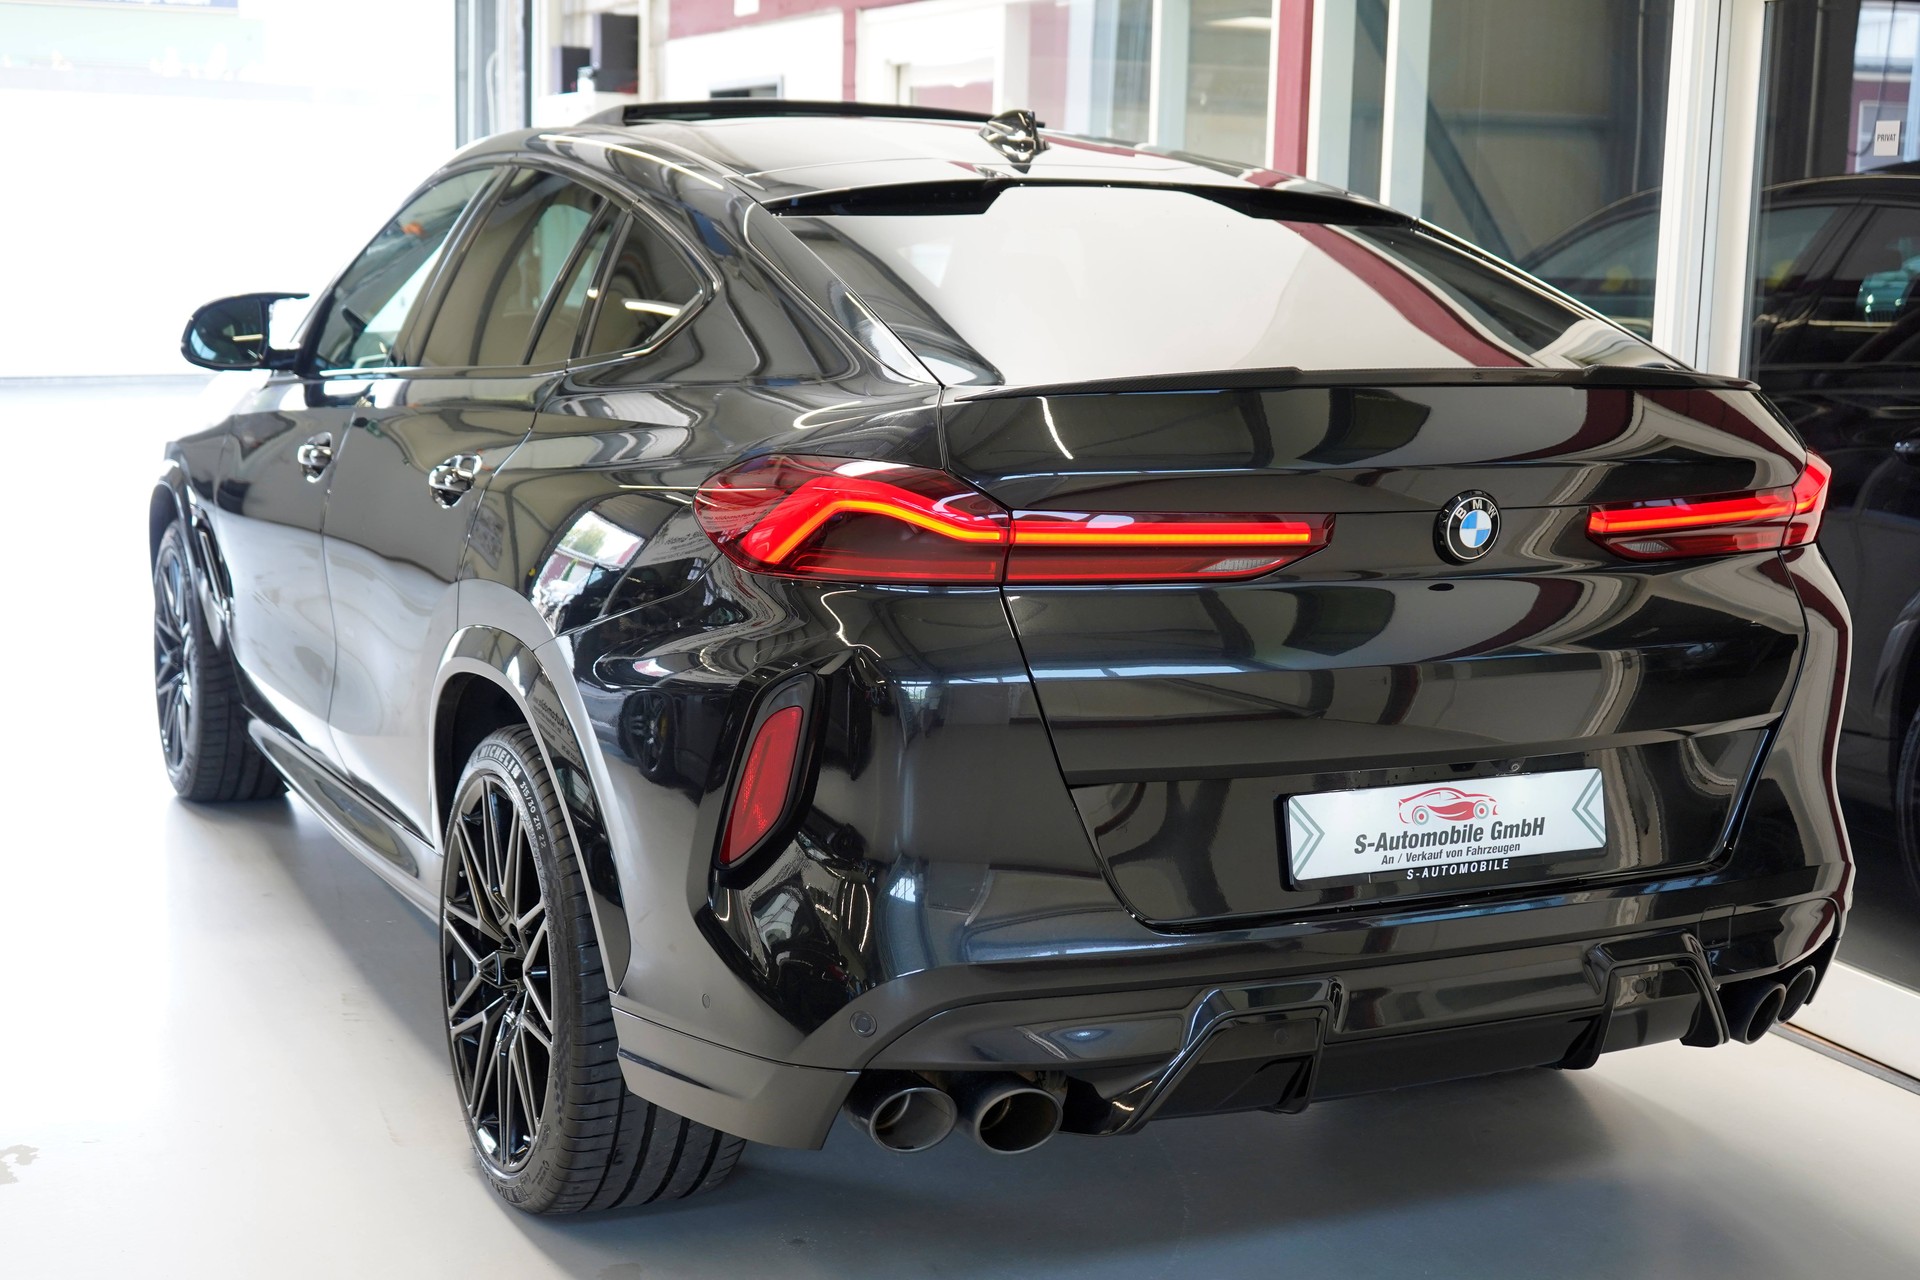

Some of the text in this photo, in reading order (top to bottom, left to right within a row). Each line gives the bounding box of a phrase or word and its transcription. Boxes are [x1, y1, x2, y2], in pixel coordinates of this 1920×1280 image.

[1877, 133, 1896, 142] PRIVAT
[1455, 499, 1497, 520] BMW
[480, 745, 522, 779] MICHELIN
[519, 781, 536, 813] 315/30
[533, 815, 542, 831] ZR
[539, 834, 547, 848] 22
[1354, 817, 1546, 855] S-Automobile GmbH
[1381, 854, 1394, 865] An
[1406, 851, 1443, 863] Verkauf
[1446, 849, 1463, 858] von
[1466, 843, 1521, 857] Fahrzeugen
[1406, 859, 1510, 880] S-AUTOMOBILE
